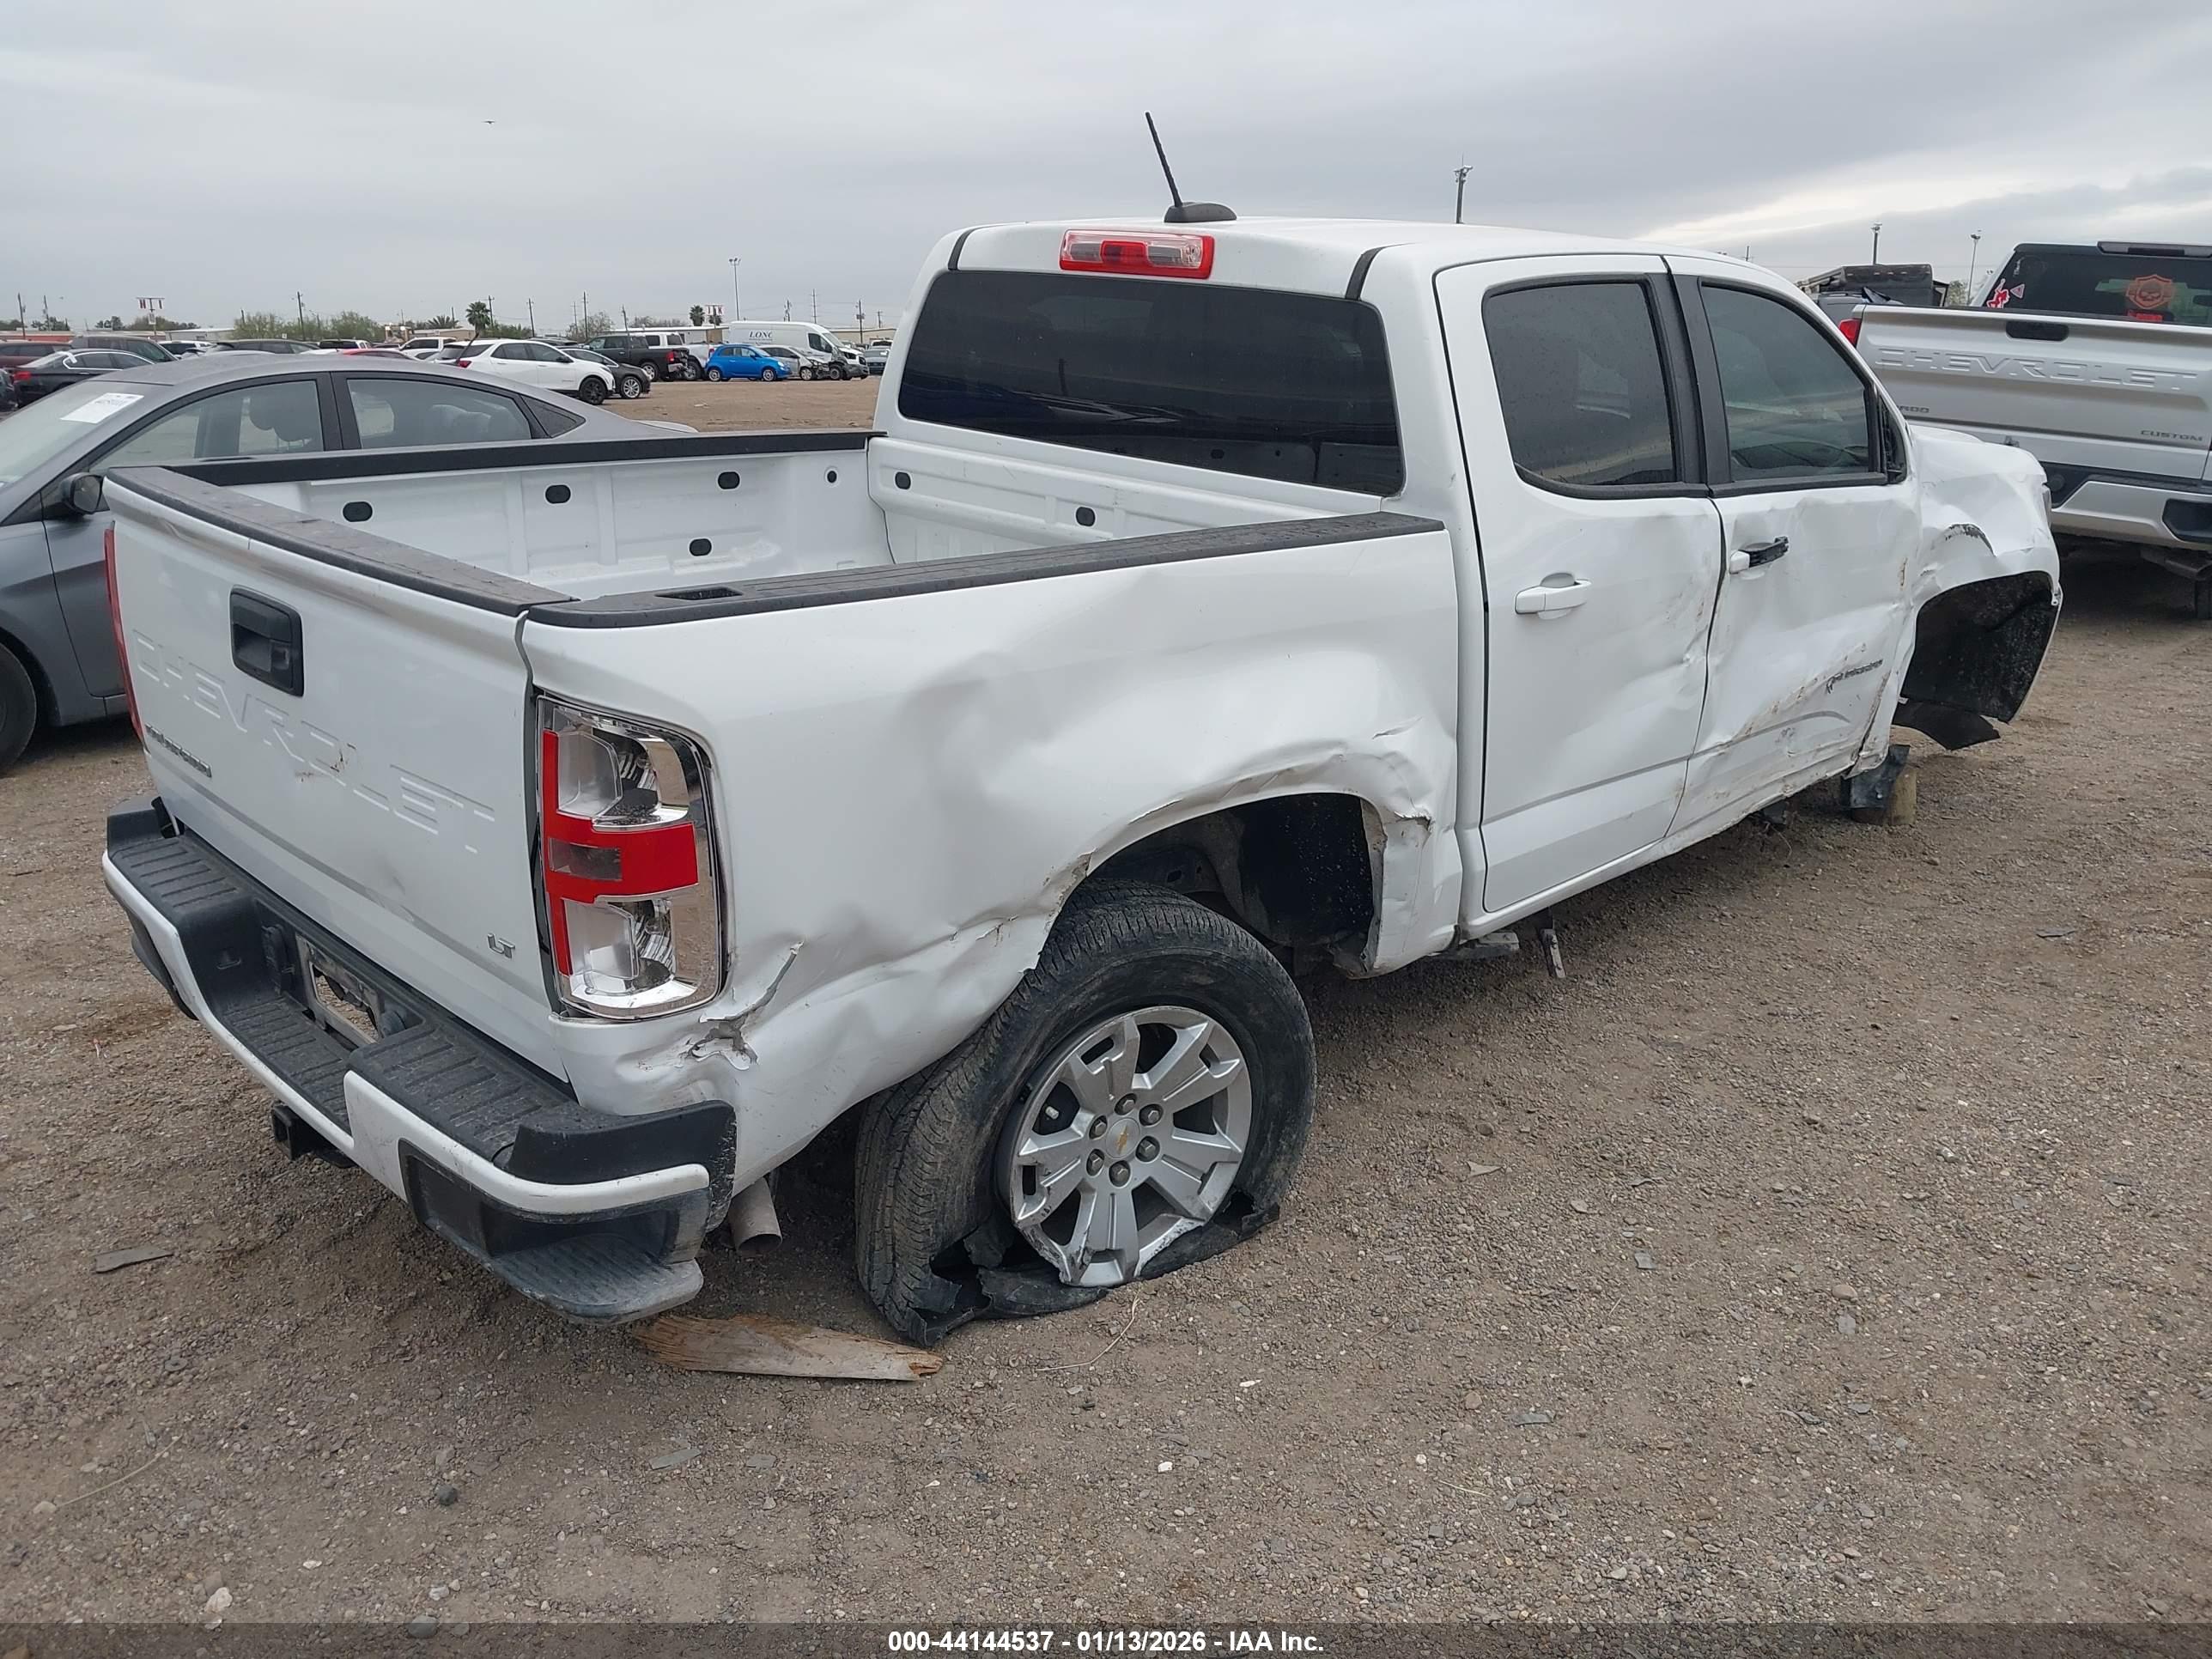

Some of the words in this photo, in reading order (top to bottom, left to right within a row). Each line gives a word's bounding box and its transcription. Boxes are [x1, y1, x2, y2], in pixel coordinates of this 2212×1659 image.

[1875, 348, 2198, 391] CHEVROLET
[2141, 429, 2203, 441] CUSTOM
[133, 629, 495, 853] CHEVROLET
[487, 933, 516, 959] LT
